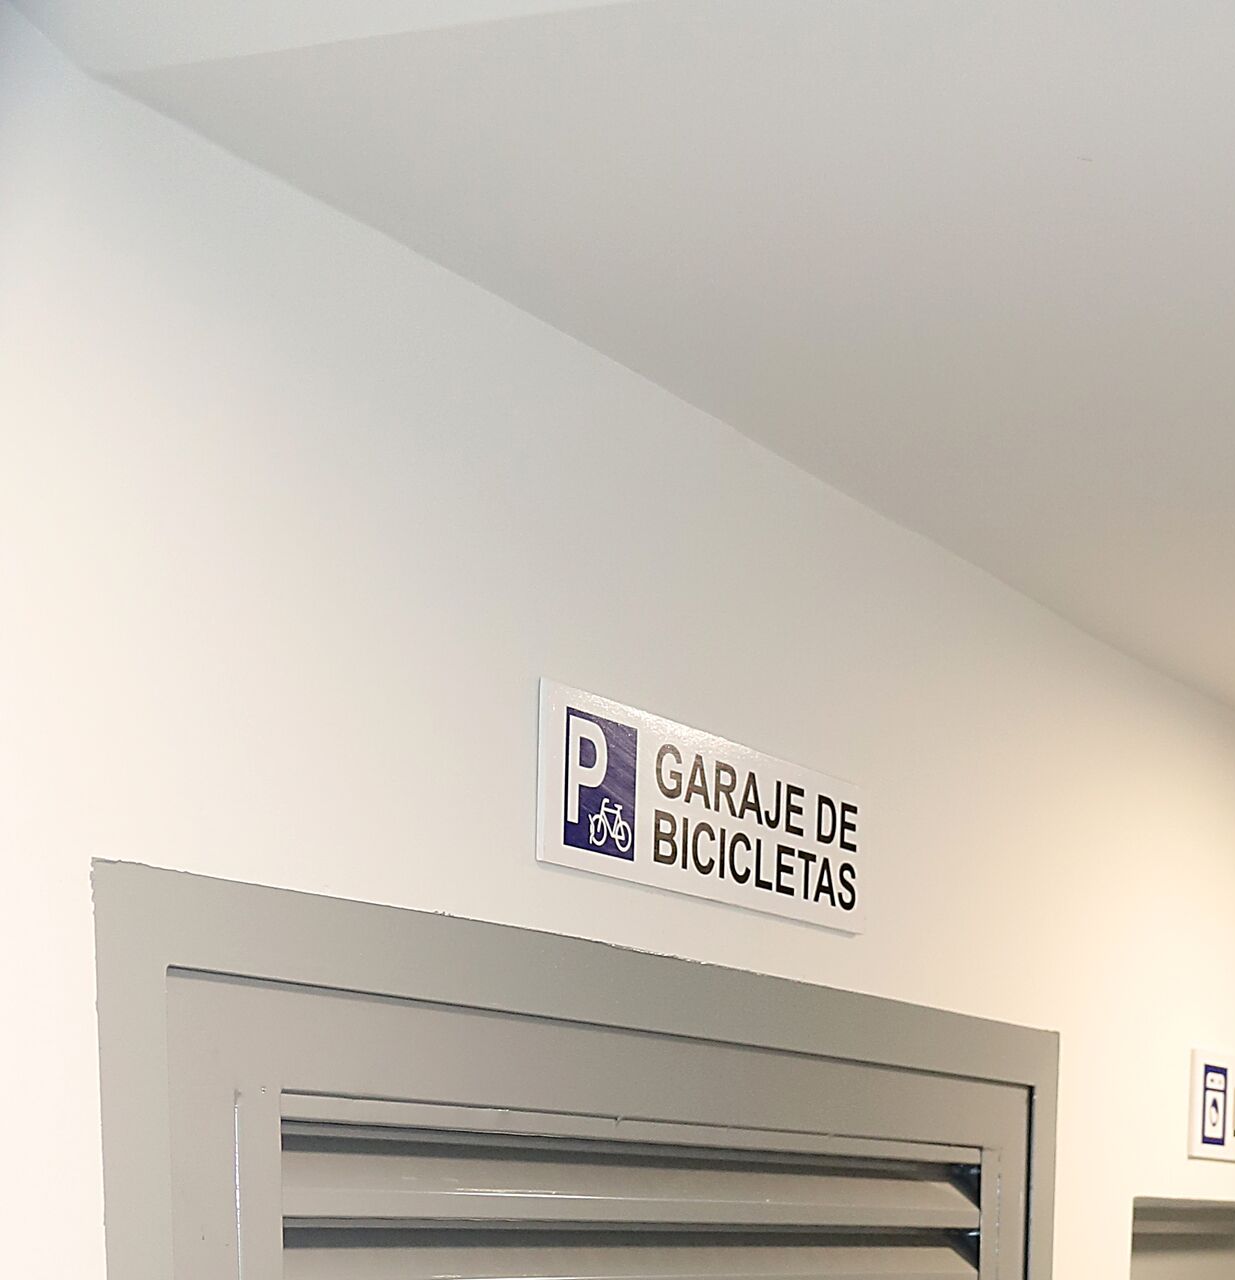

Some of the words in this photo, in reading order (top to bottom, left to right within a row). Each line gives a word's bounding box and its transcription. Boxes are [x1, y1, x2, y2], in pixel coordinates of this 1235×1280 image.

[567, 713, 608, 824] P
[655, 744, 806, 837] GARAJE
[817, 794, 858, 852] DE
[653, 809, 857, 911] BICICLETAS
